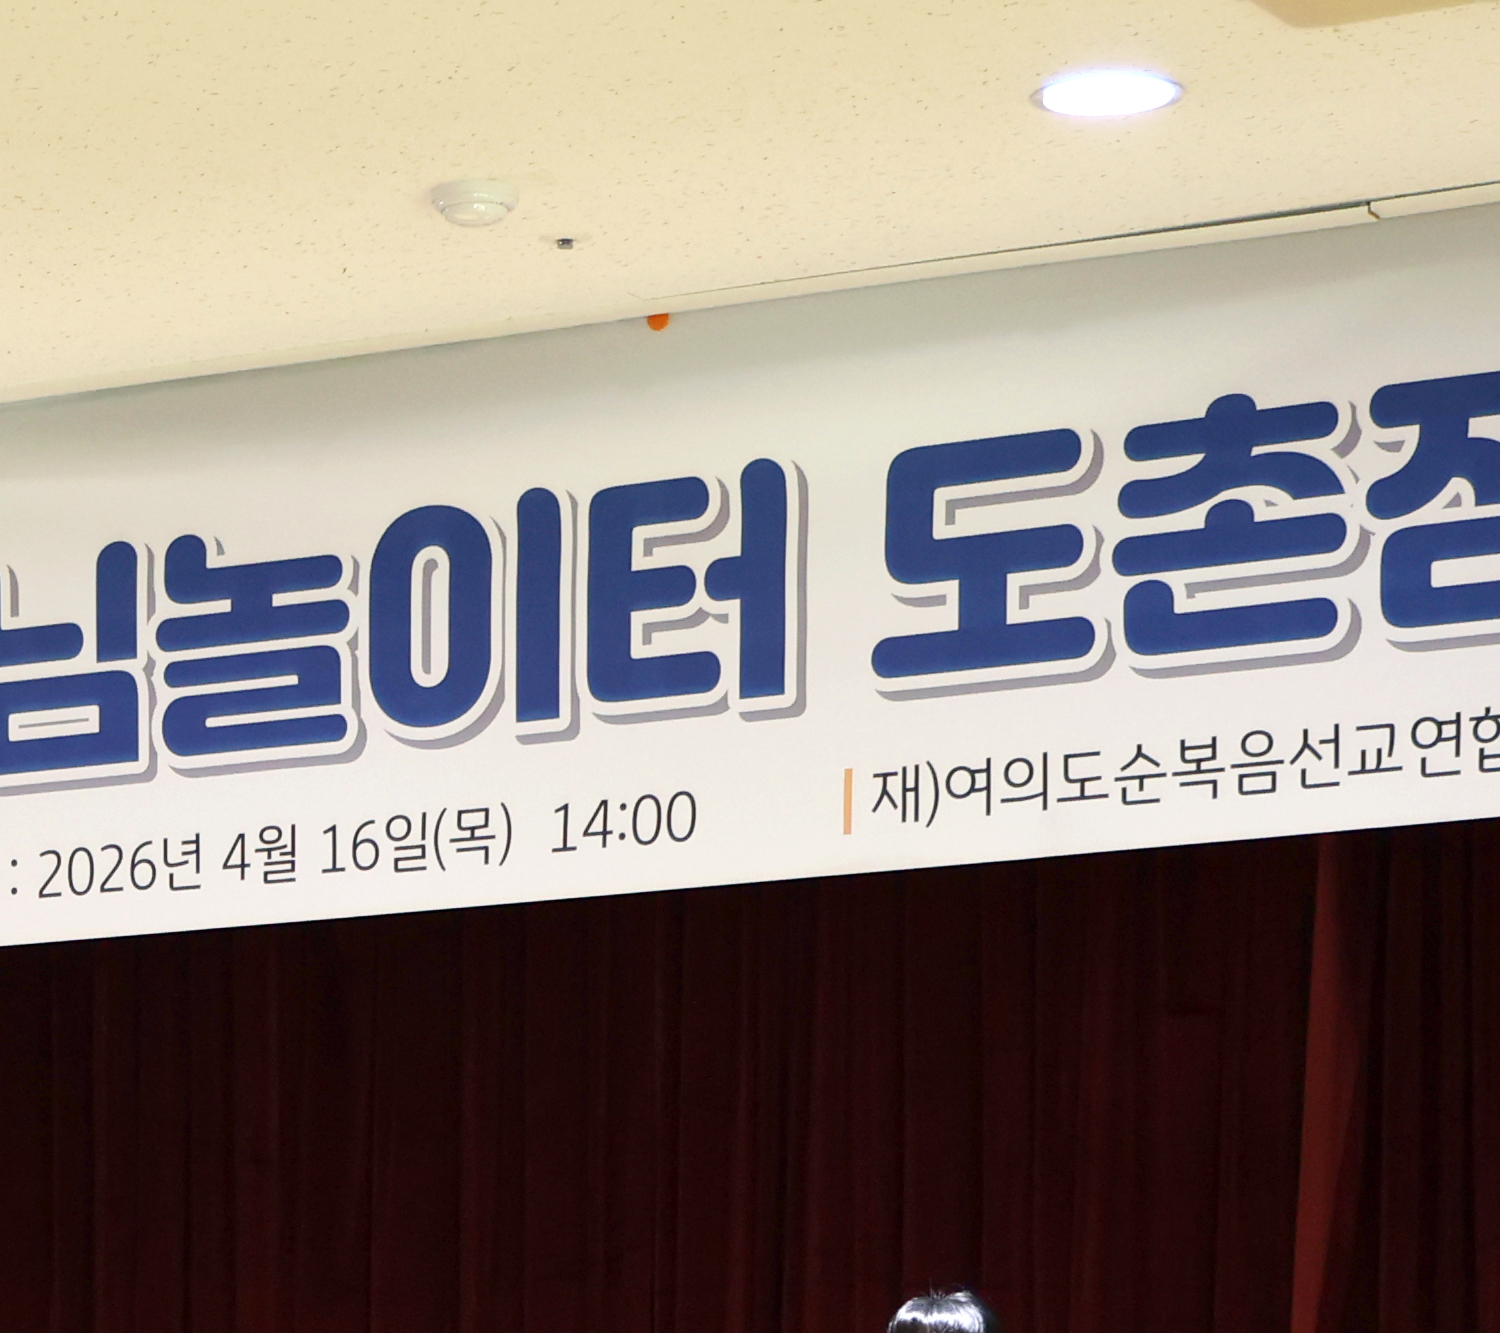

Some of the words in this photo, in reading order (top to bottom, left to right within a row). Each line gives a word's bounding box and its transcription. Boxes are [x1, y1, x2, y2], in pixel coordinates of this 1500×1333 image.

[37, 831, 202, 900] 2026년
[221, 823, 299, 884] 4월
[320, 800, 514, 876] 16일(목)
[550, 789, 698, 854] 14:00
